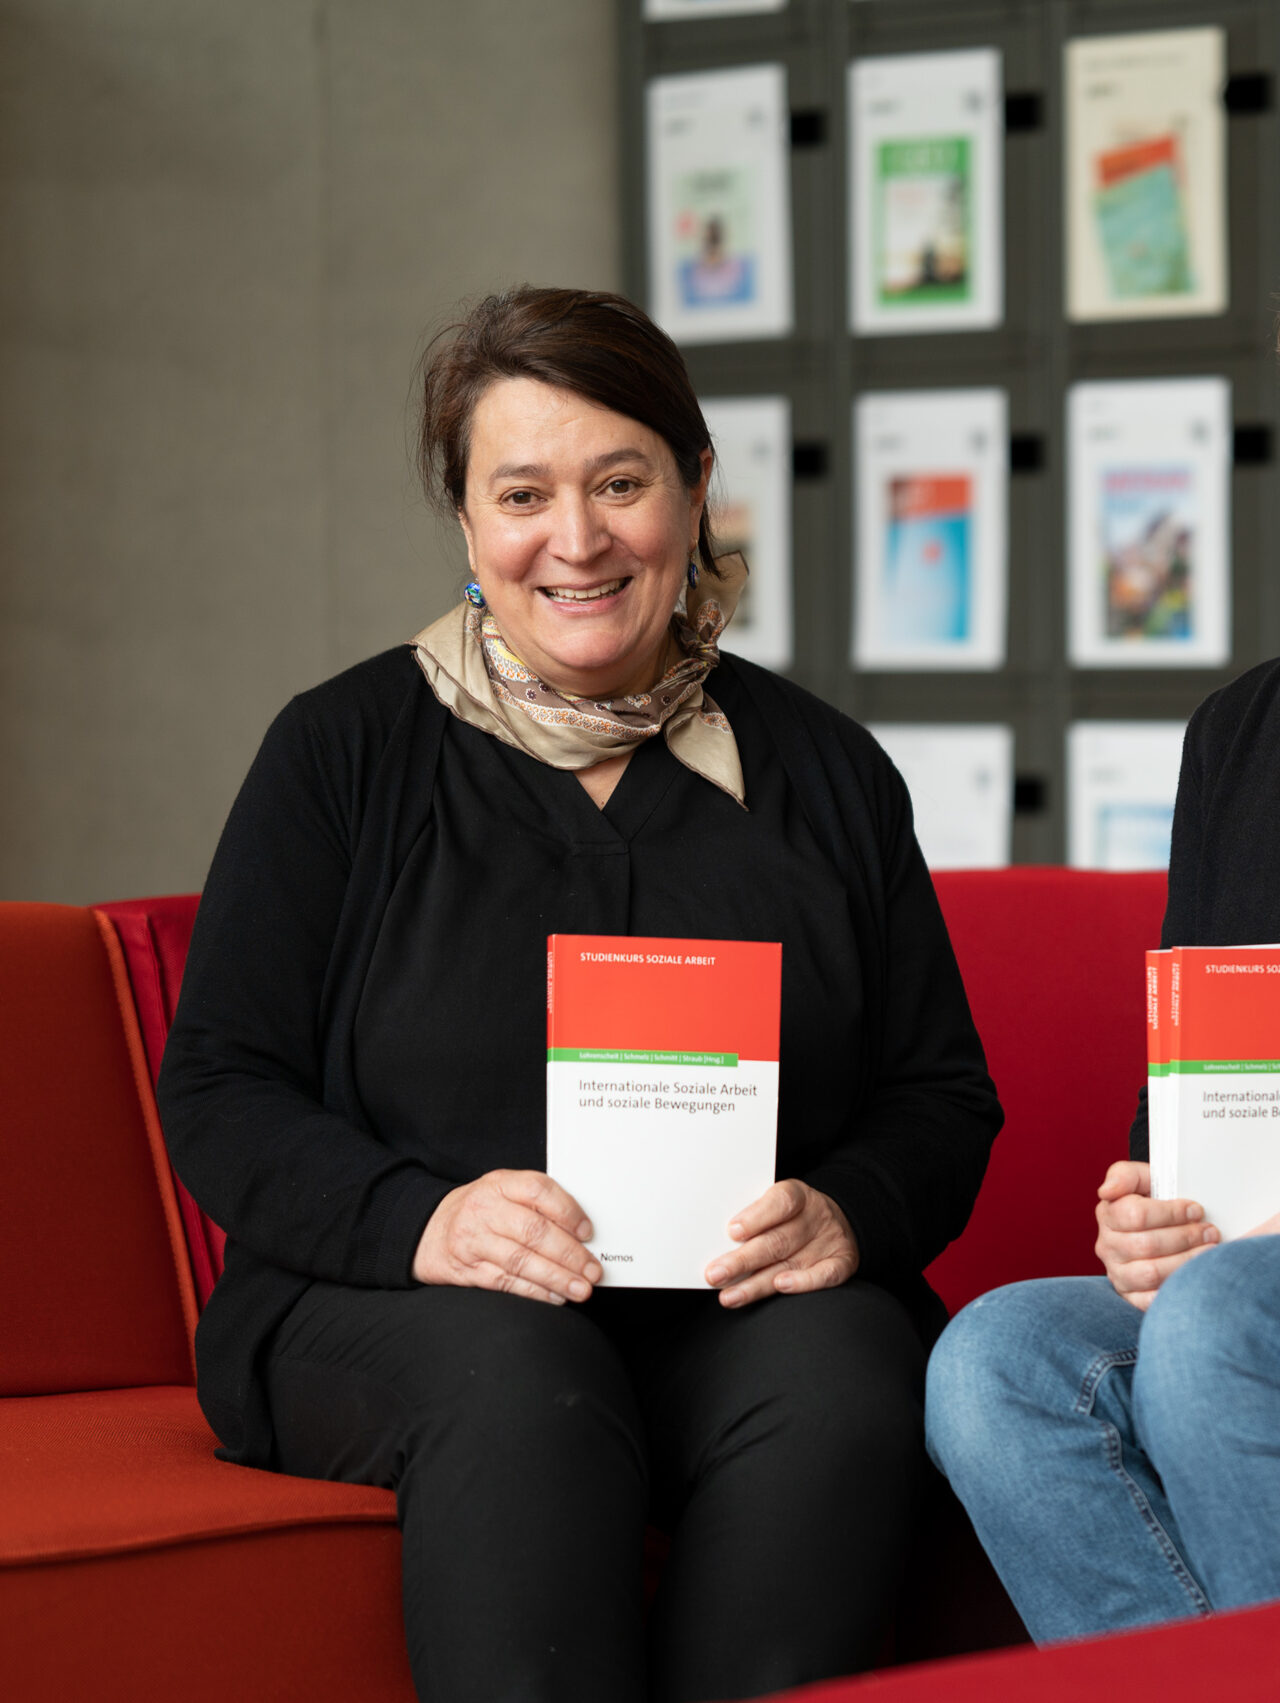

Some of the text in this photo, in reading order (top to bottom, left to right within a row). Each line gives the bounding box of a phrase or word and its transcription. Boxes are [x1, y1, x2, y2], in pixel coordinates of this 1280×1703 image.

[580, 952, 716, 966] STUDIENKURS SOZIALE ARBEIT
[1205, 964, 1265, 974] STUDIENKURS
[579, 1079, 758, 1096] Internationale Soziale Arbeit
[579, 1097, 736, 1115] und soziale Bewegungen
[1203, 1107, 1226, 1118] und
[1229, 1106, 1268, 1118] soziale
[600, 1253, 634, 1262] Nomos
